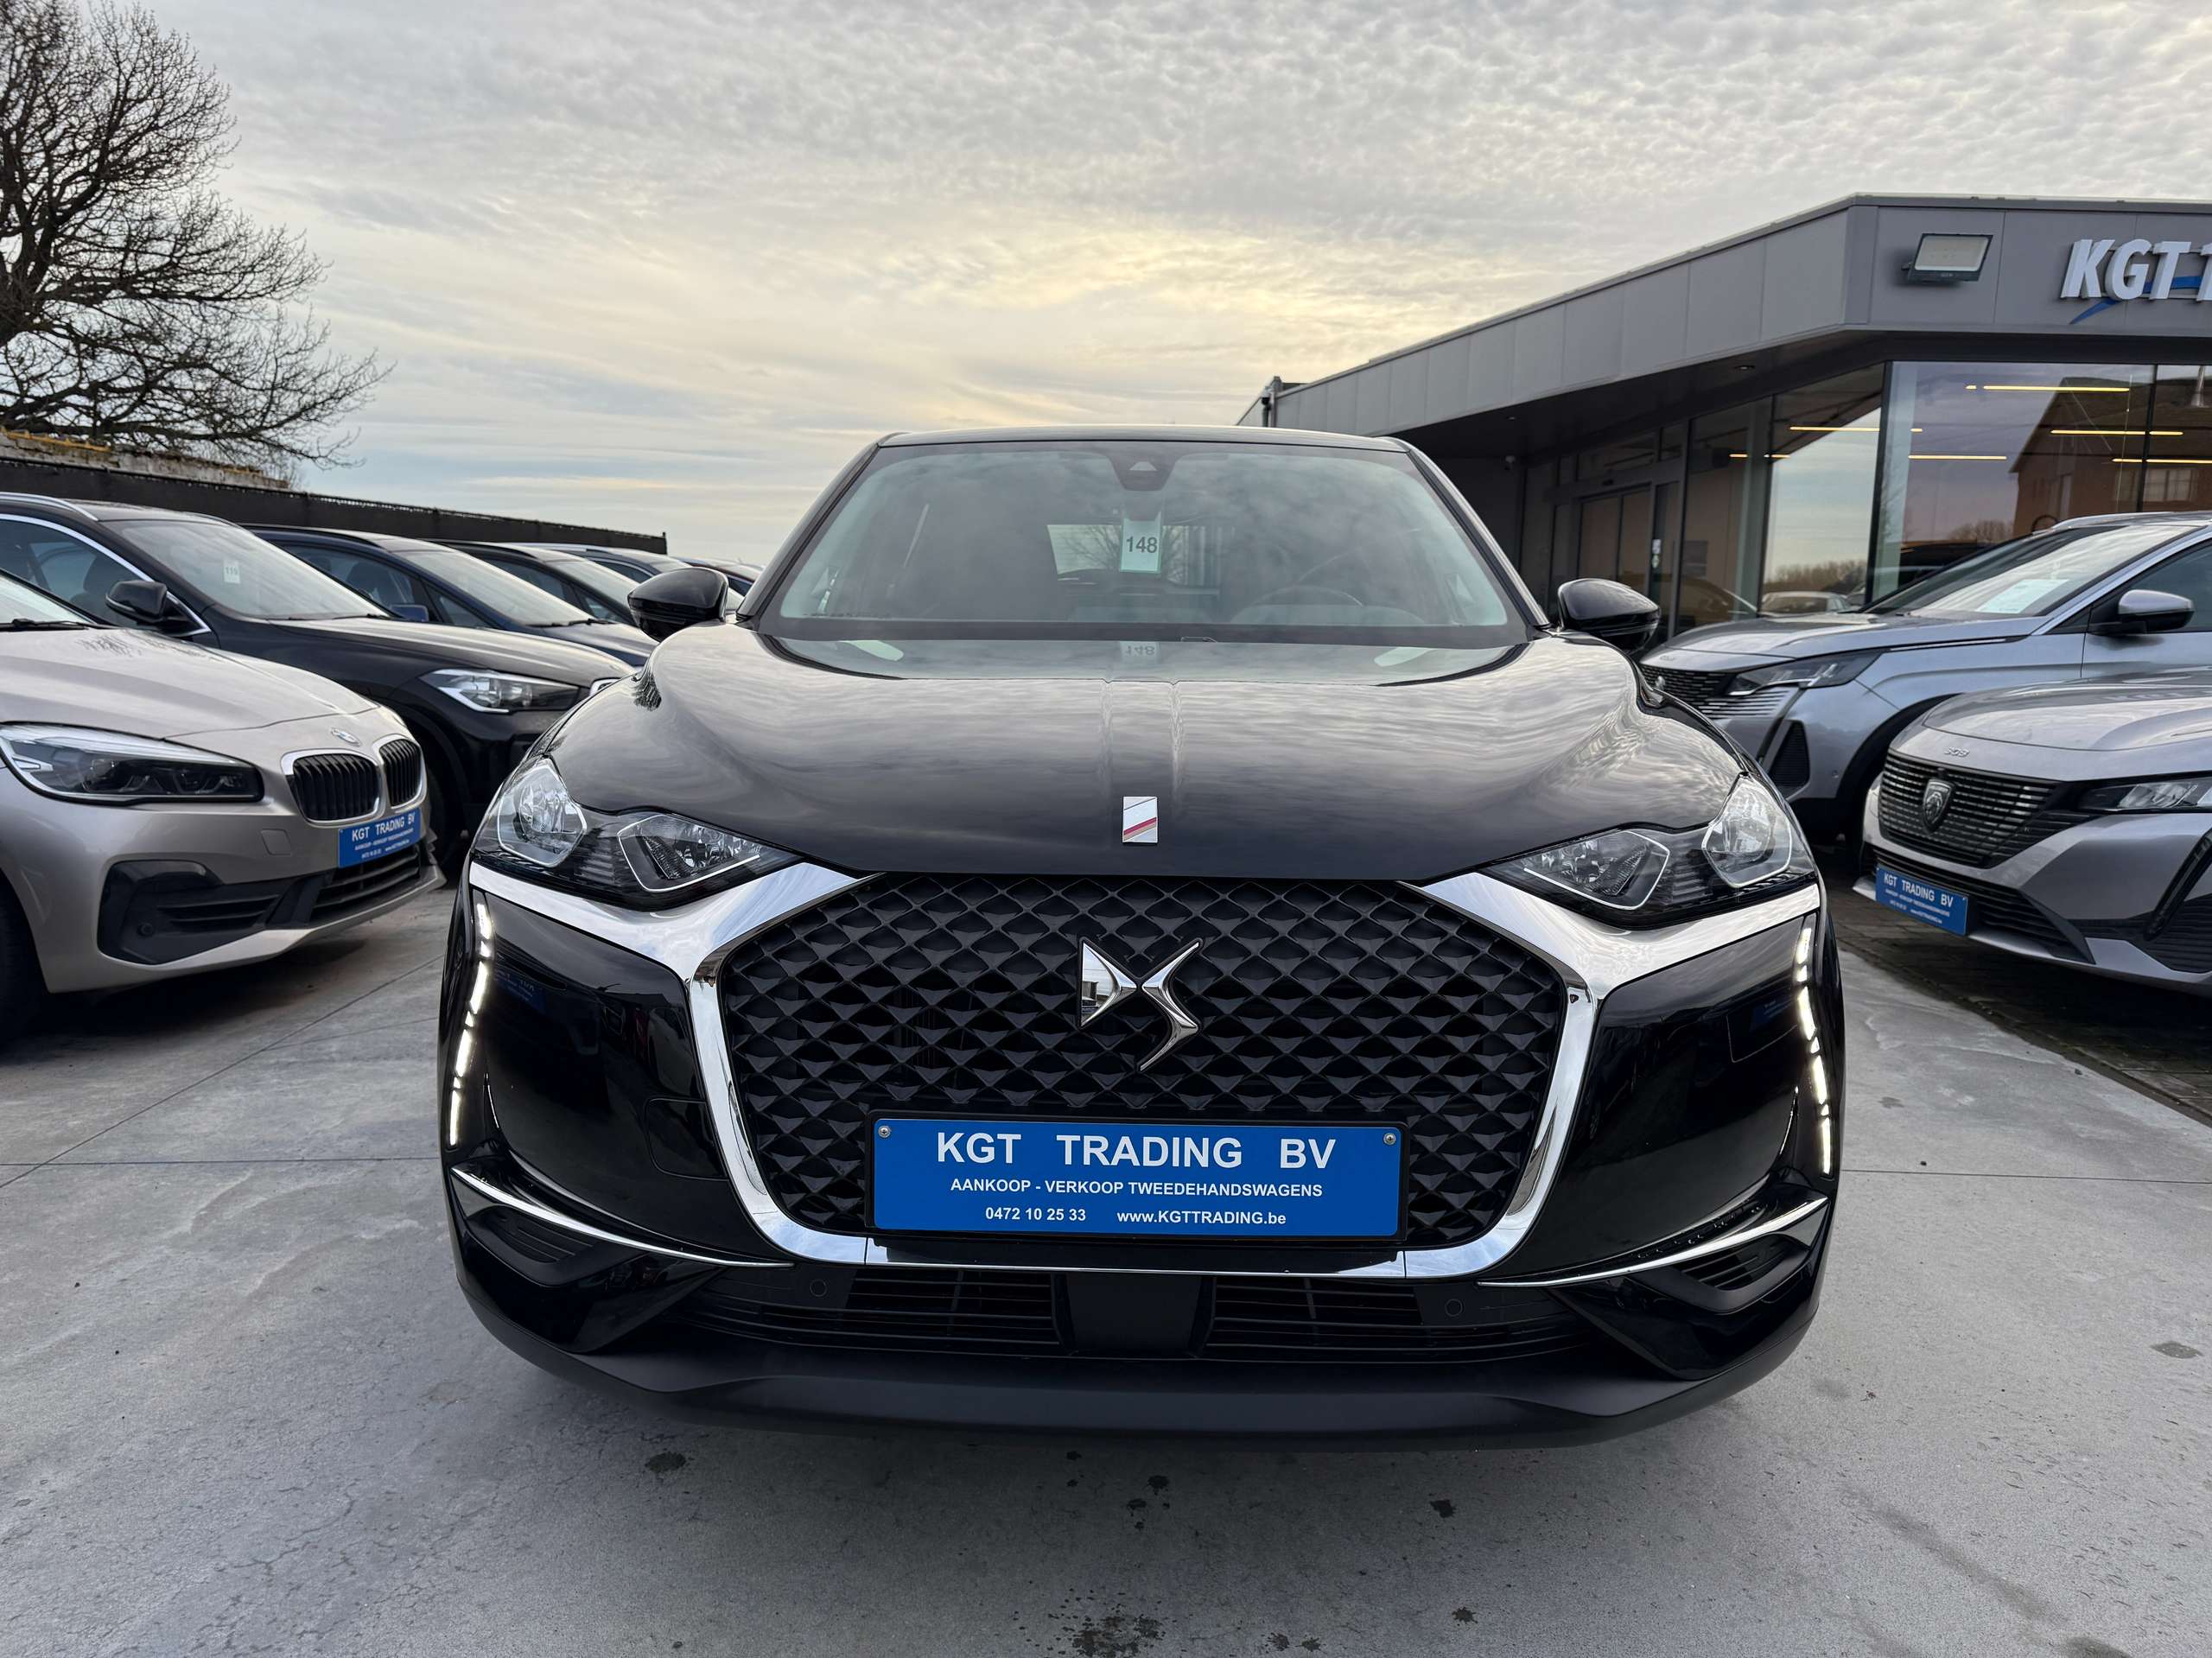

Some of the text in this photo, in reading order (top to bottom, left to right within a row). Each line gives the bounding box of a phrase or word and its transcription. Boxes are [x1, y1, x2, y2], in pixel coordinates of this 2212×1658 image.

[2060, 238, 2192, 300] KGT
[1126, 536, 1158, 553] 148
[352, 827, 370, 842] KGT
[375, 816, 405, 835] TRADING
[1884, 873, 1897, 887] KGT
[1902, 880, 1936, 902] TRADING
[1941, 893, 1954, 908] BV
[938, 1132, 1336, 1169] KGT TRADING BV
[950, 1178, 1031, 1192] AANKOOP
[1044, 1180, 1124, 1194] VERKOOP
[1128, 1182, 1323, 1197] TWEEDEHANDSWAGENS
[985, 1207, 1287, 1224] 0472 10 25 33 www.KGTTRADING.be
